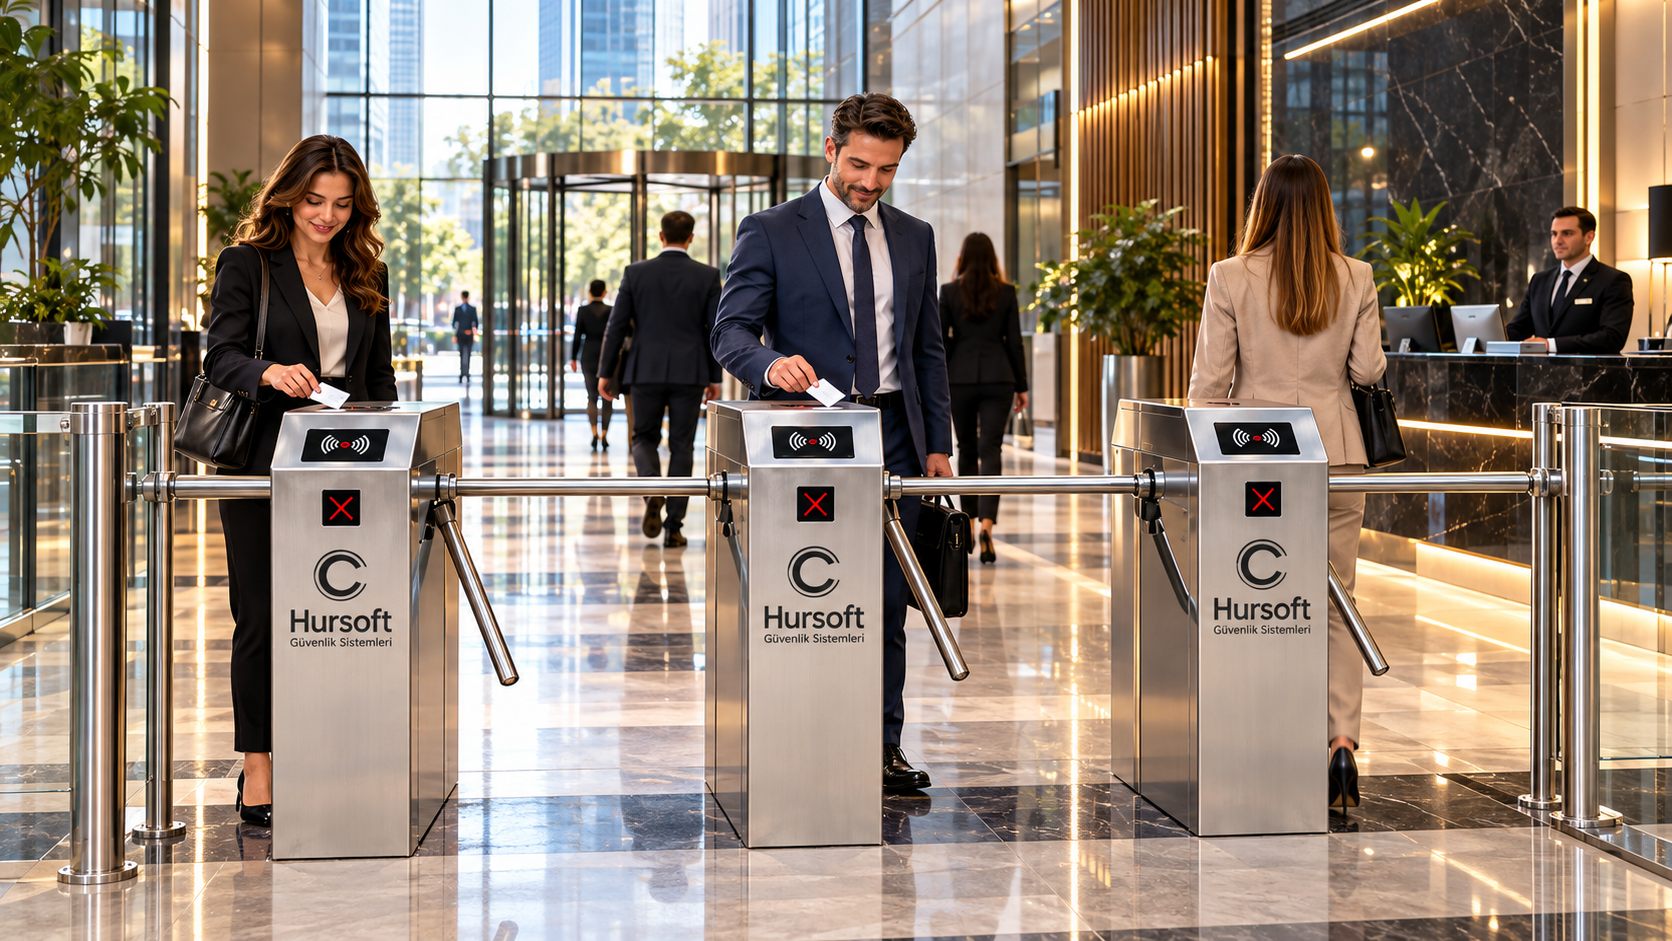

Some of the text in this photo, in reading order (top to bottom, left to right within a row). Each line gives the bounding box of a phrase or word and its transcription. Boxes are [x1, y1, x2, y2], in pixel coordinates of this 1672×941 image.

[765, 604, 864, 629] Hursoft
[1214, 596, 1311, 620] Hursoft
[291, 608, 392, 633] Hursoft
[764, 633, 864, 644] Güvenlik Sistemleri
[1214, 625, 1311, 635] Güvenlik Sistemleri
[290, 637, 392, 647] Güvenlik Sistemleri
